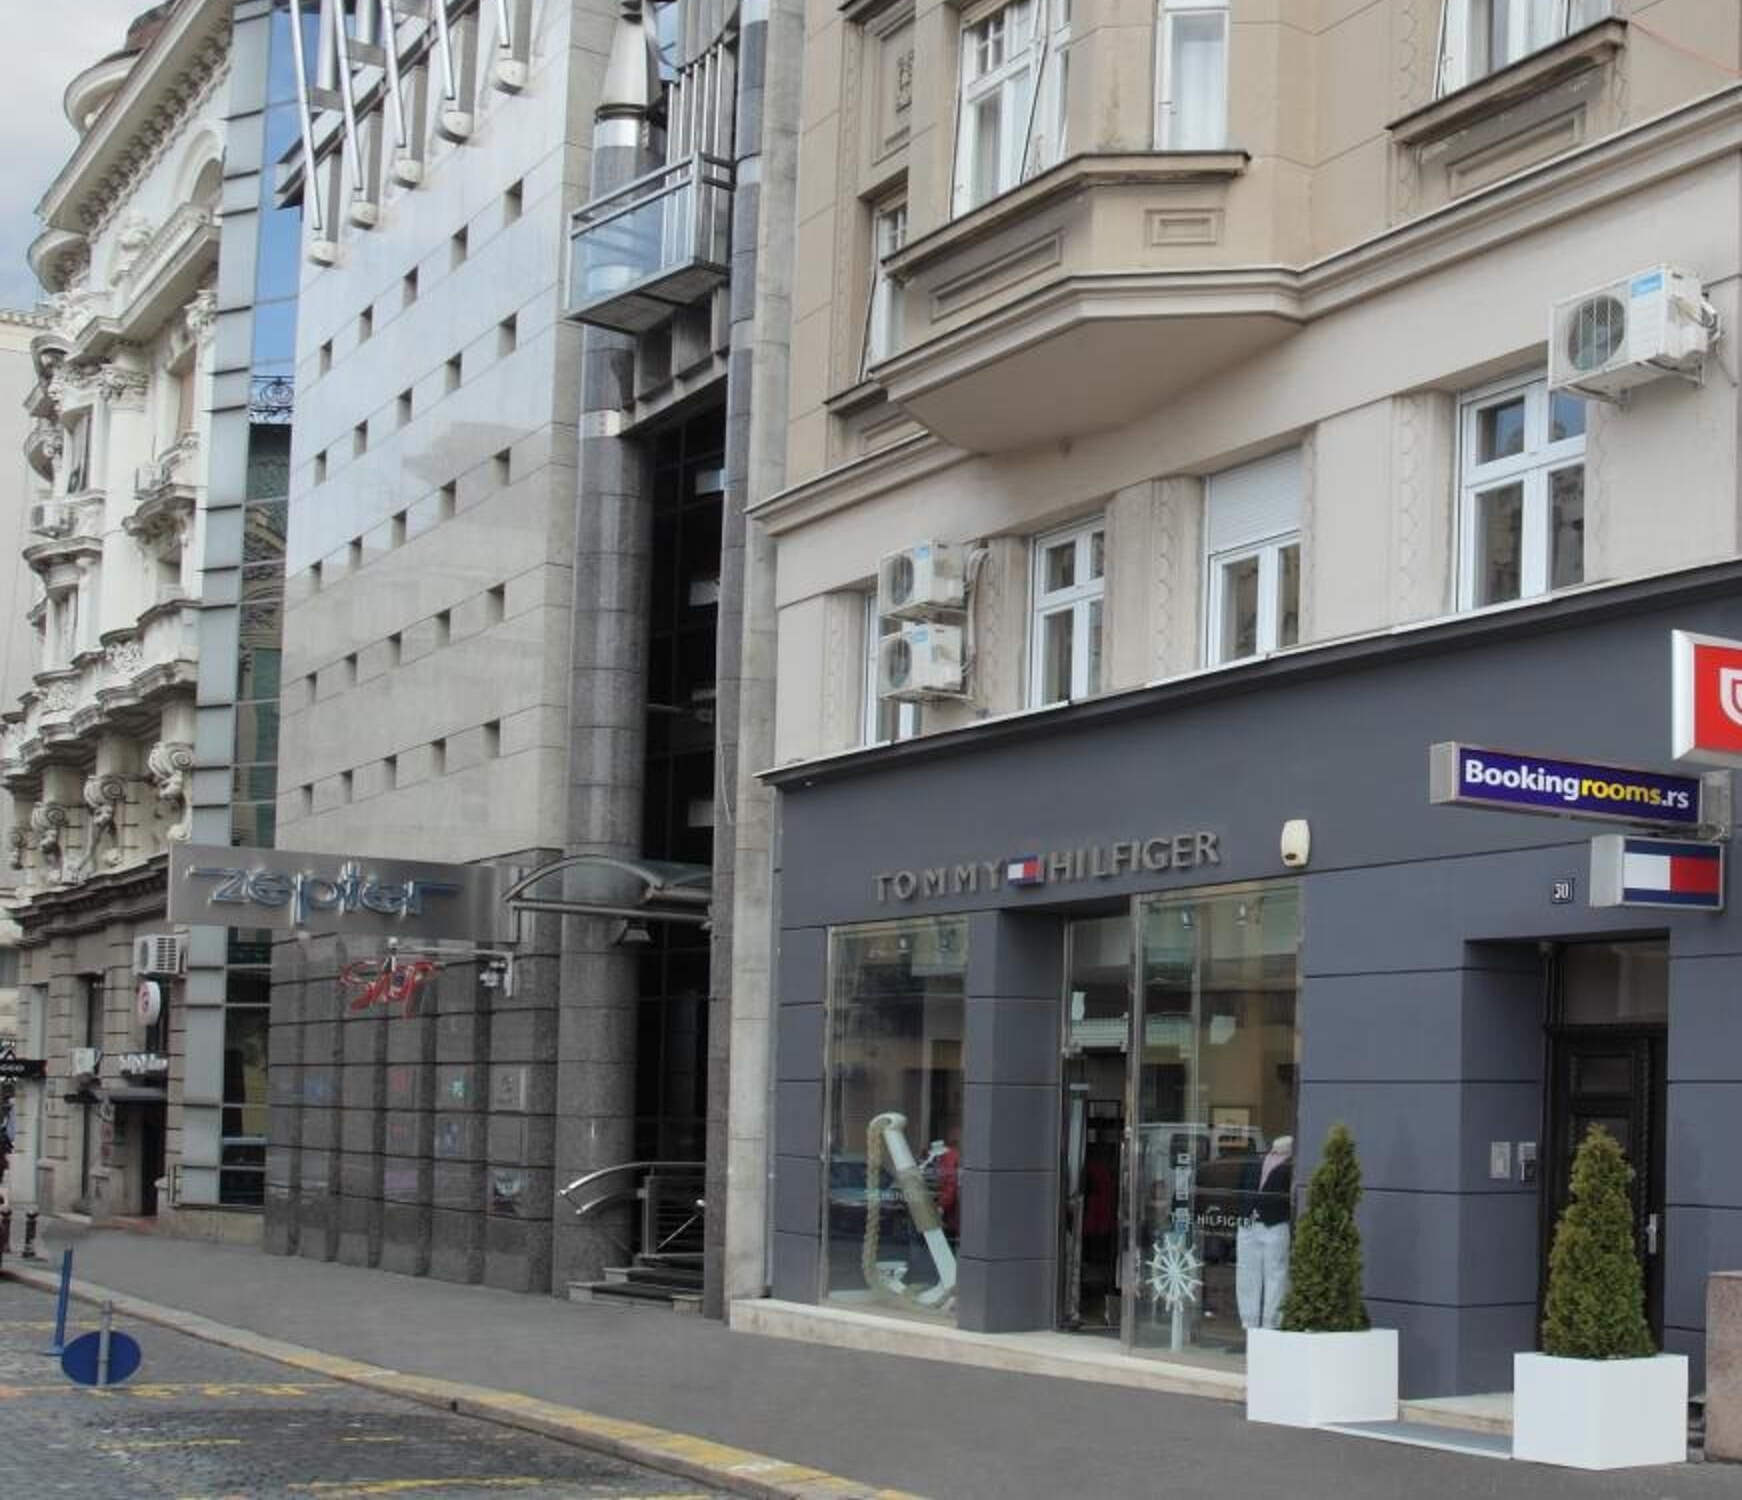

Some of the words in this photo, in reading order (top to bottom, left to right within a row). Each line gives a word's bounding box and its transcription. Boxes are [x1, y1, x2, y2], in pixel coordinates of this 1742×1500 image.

[1464, 759, 1690, 809] Bookingrooms.rs
[184, 860, 464, 927] zepter
[873, 857, 1004, 902] TOMMY
[1047, 831, 1220, 883] HILFIGER
